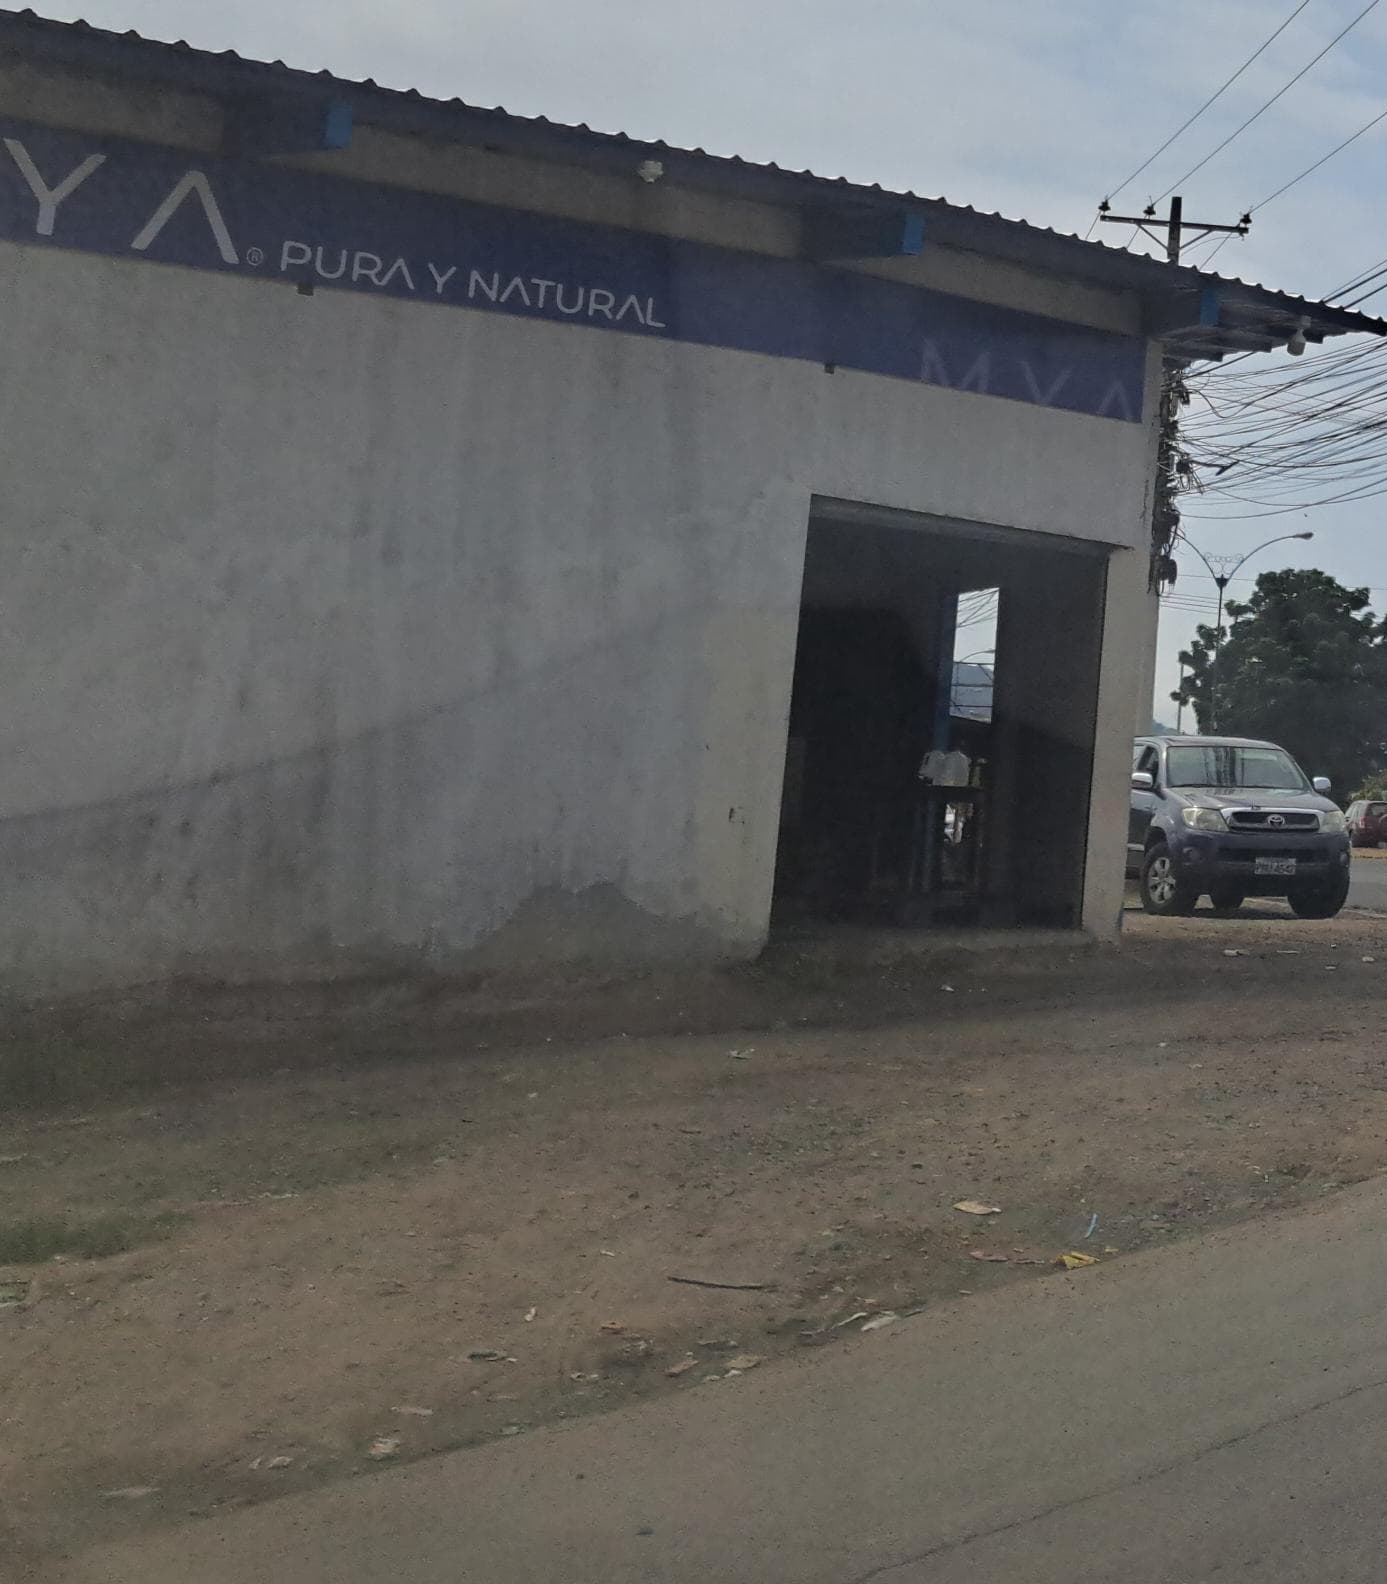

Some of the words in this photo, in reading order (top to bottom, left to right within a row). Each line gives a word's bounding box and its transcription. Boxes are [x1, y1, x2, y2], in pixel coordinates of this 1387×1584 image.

[280, 240, 415, 291] PURA
[428, 263, 456, 294] Y
[469, 270, 666, 329] NATURAL
